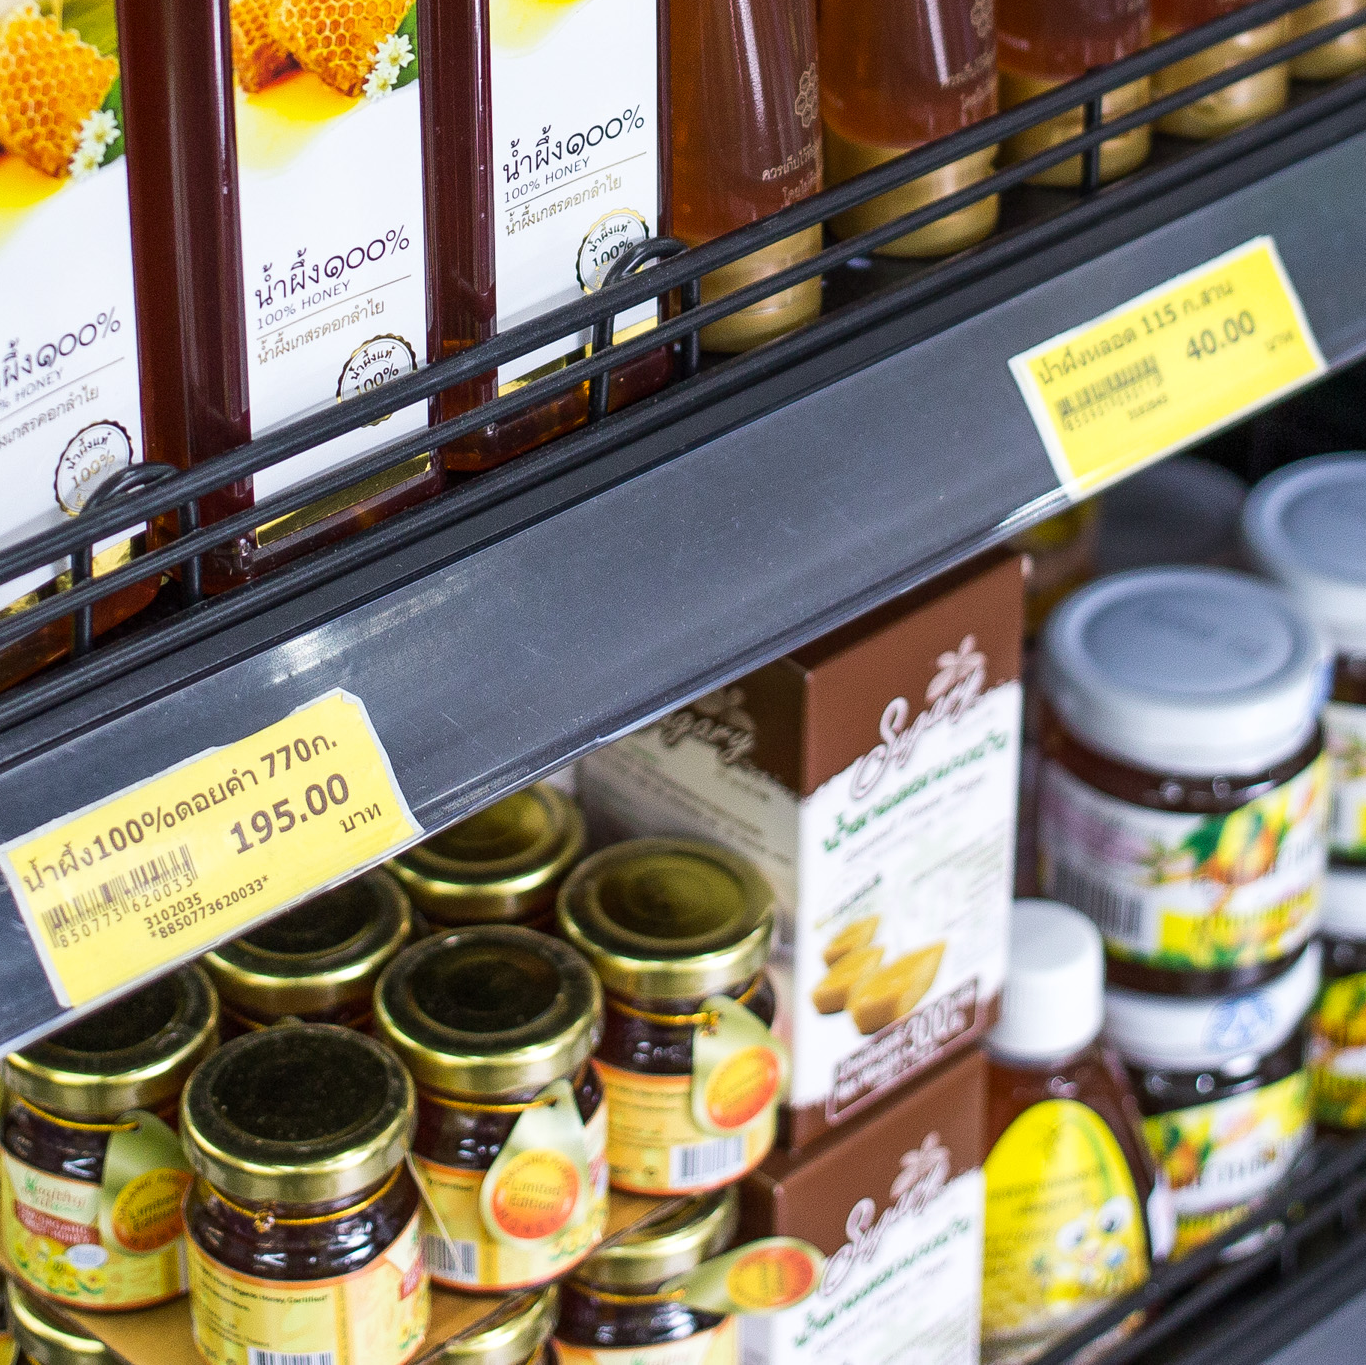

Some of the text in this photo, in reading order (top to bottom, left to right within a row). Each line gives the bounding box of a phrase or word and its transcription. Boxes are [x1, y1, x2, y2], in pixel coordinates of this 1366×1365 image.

[502, 104, 645, 184] น้ำผึ้ง๑๐๐%
[504, 156, 590, 204] 100% HONEY
[253, 223, 411, 310] น้ำผึ้ง๑๐๐%
[591, 236, 634, 269] 100%
[257, 279, 351, 331] 100% HONEY
[1139, 302, 1179, 336] 115
[1185, 308, 1257, 361] 40.00
[14, 367, 64, 403] HONEY
[353, 362, 400, 396] 100%
[70, 449, 116, 487] 100%
[22, 731, 339, 895] น้ำผึ้ง100%ดอยคำ 770ก.
[228, 771, 351, 856] 195.00
[338, 801, 383, 836] บาท
[143, 892, 203, 930] 3102035
